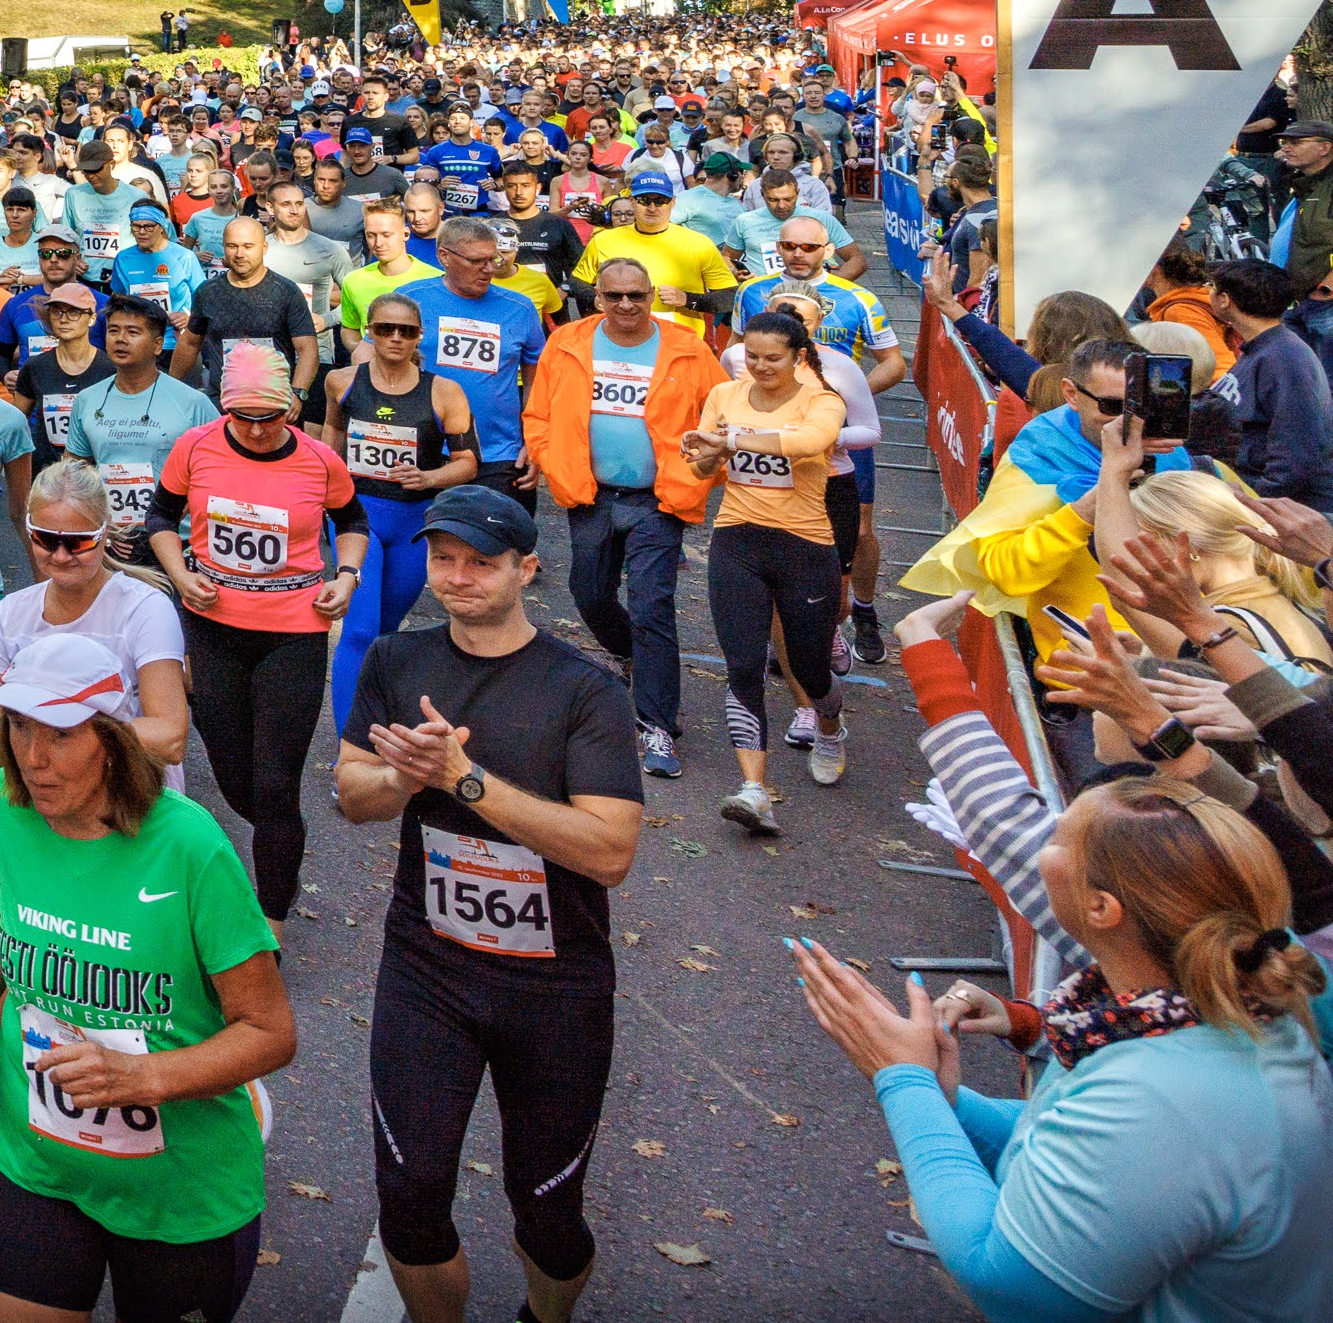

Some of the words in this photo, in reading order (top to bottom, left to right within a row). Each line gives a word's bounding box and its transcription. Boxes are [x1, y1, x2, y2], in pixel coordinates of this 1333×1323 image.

[447, 192, 476, 204] 2267
[84, 238, 119, 251] 1074
[443, 334, 496, 363] 878
[96, 418, 116, 430] Aeg
[118, 418, 129, 428] ei
[108, 430, 149, 441] liigume!
[350, 443, 416, 469] 1306
[729, 450, 790, 477] 1263
[213, 525, 281, 564] 560
[223, 576, 247, 584] adidas
[223, 583, 248, 591] adidas
[517, 872, 529, 882] 10
[429, 876, 549, 931] 1564
[17, 913, 76, 944] VIKING
[80, 927, 132, 952] LINE
[44, 943, 174, 1017] ÖÖJOOKS
[36, 997, 72, 1020] RUN
[84, 1010, 175, 1032] ESTONIA
